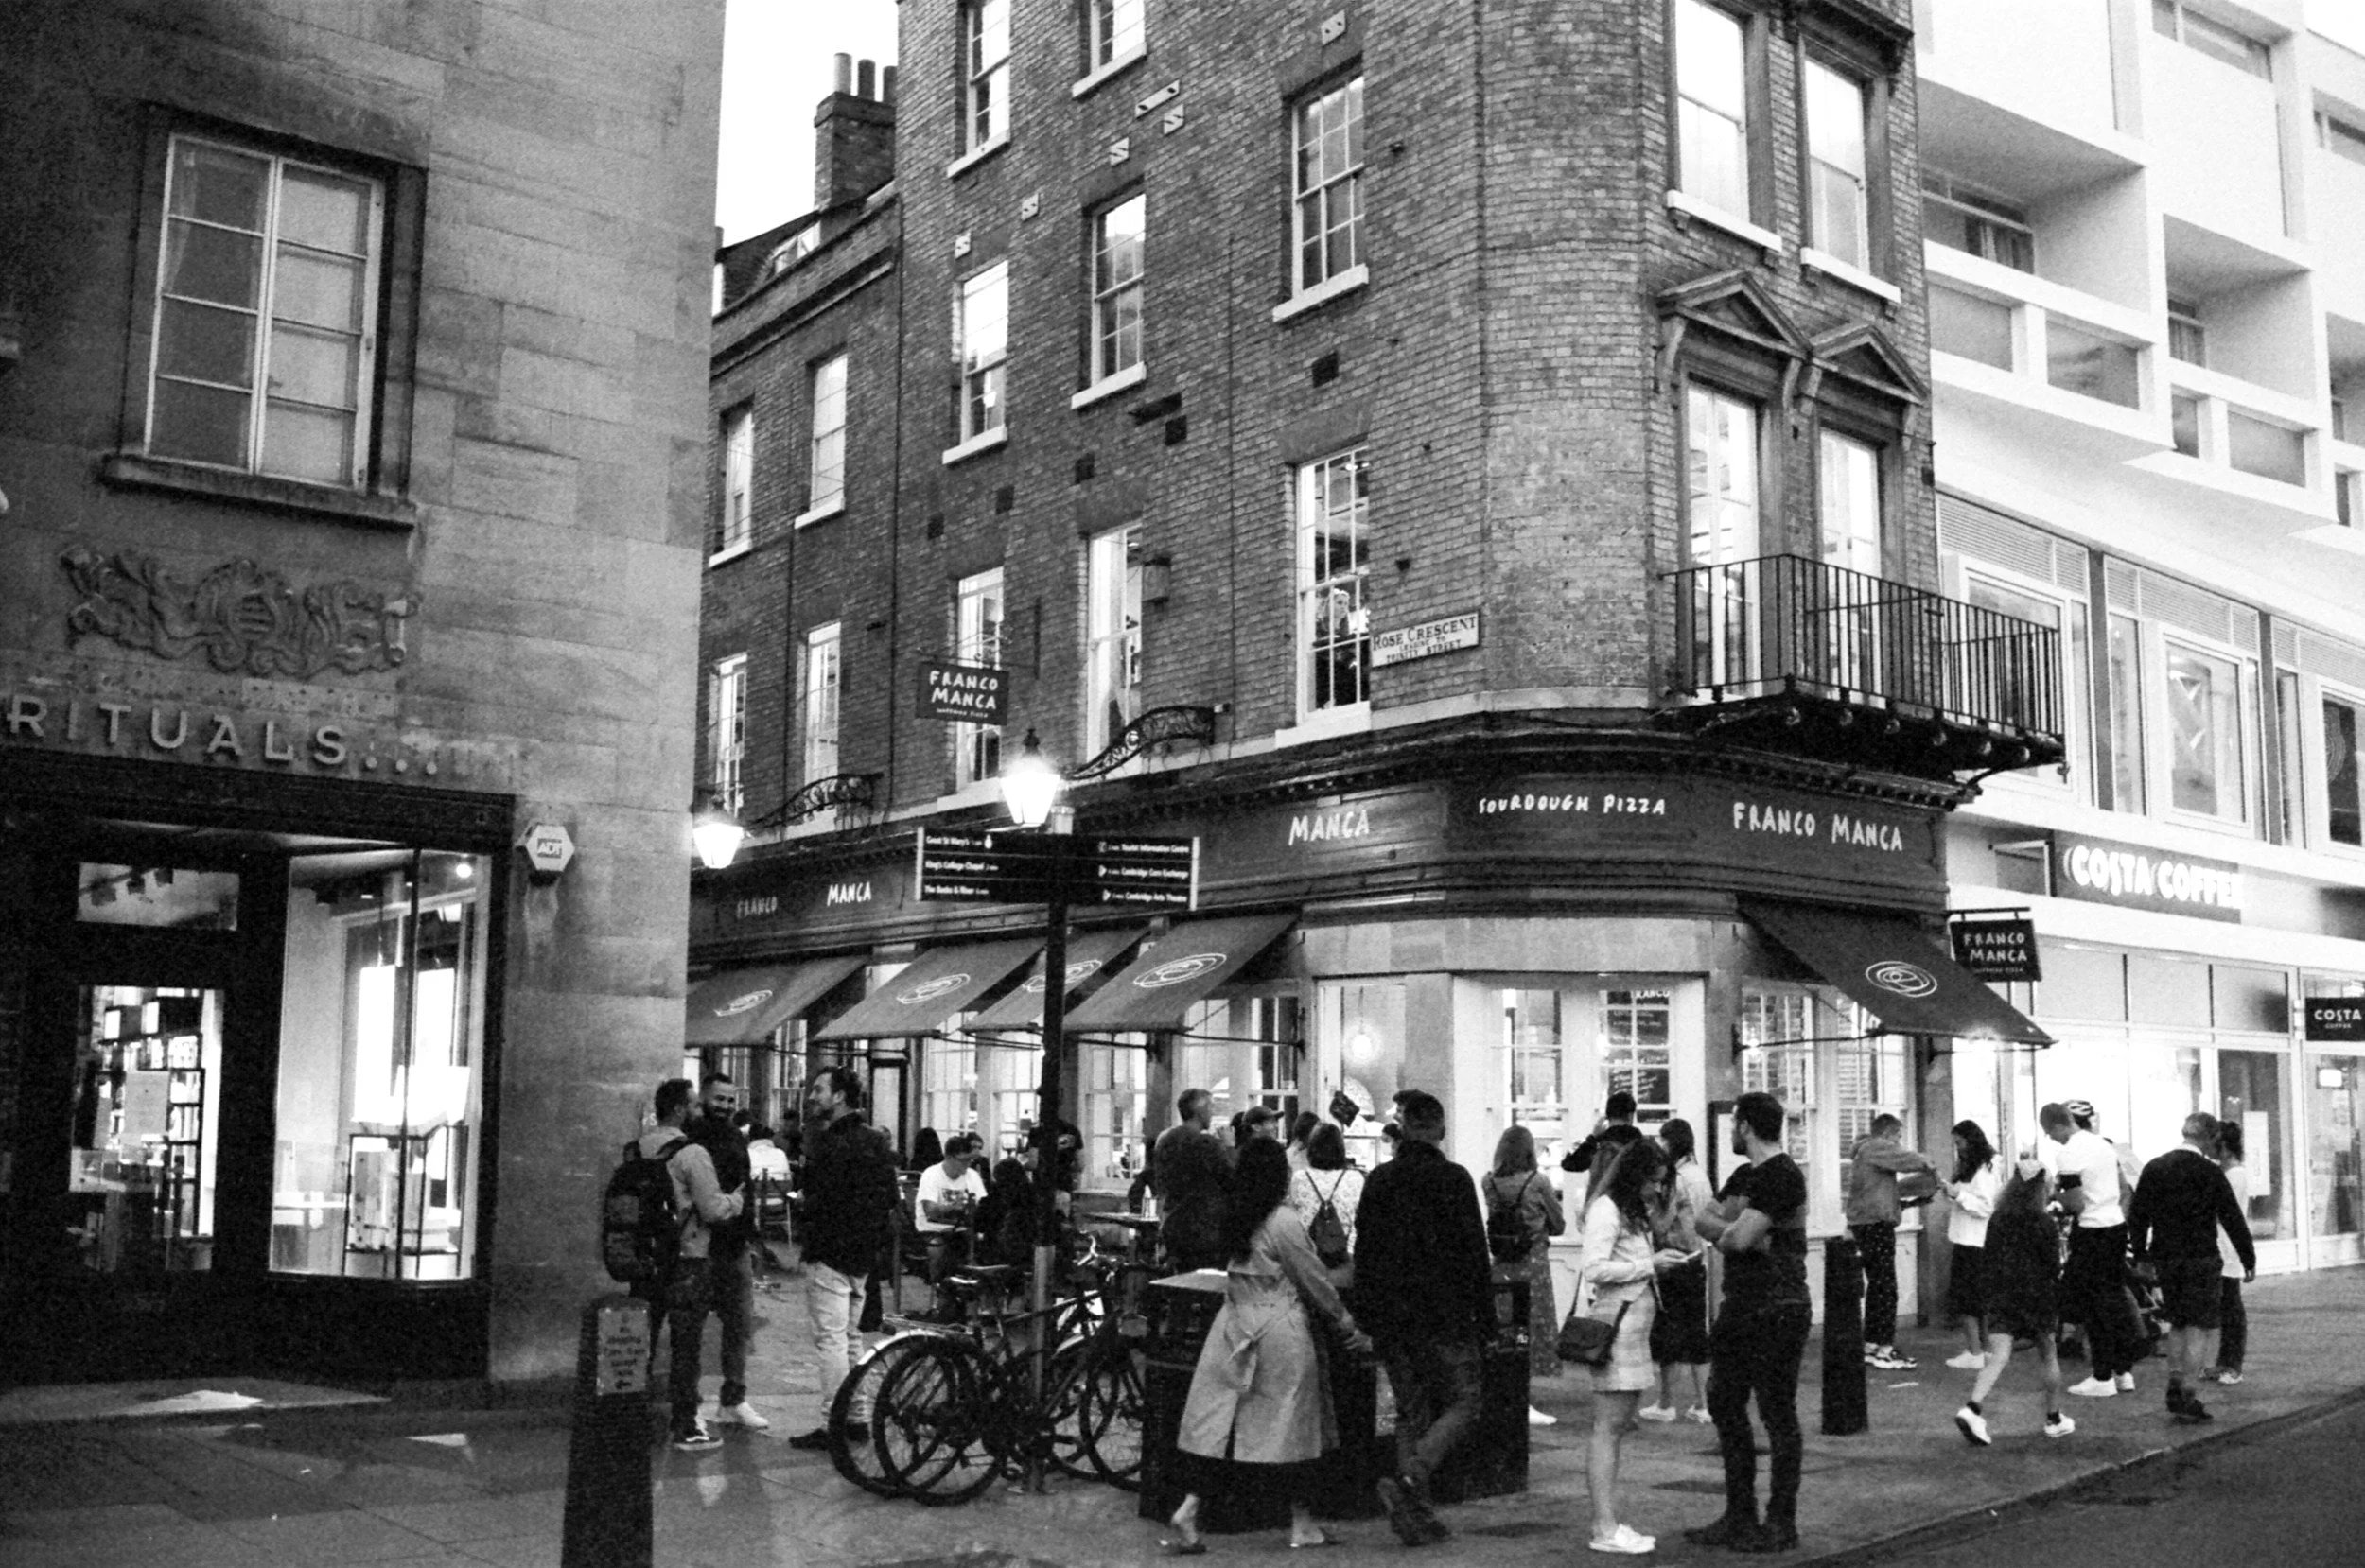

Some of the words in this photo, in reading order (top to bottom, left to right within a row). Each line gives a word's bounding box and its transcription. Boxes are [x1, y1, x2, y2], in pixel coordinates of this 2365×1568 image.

[1373, 632, 1404, 651] ROSE
[1407, 616, 1477, 642] CRESCENT
[929, 670, 999, 691] FRANCO
[931, 687, 997, 709] MANCA
[1479, 793, 1589, 814] SOURDOUGH
[1603, 793, 1666, 816] PIZZA
[1288, 809, 1370, 846] MANCA
[1733, 802, 1816, 837] FRANCO
[1831, 814, 1903, 851] MANCA
[537, 840, 563, 857] ADT
[2064, 845, 2154, 897] COSTA
[737, 896, 778, 919] FRANCO
[826, 880, 872, 907] MANCA
[1963, 932, 2025, 947] FRANCO
[1969, 948, 2028, 963] MANCA
[2314, 1008, 2363, 1022] COSTA
